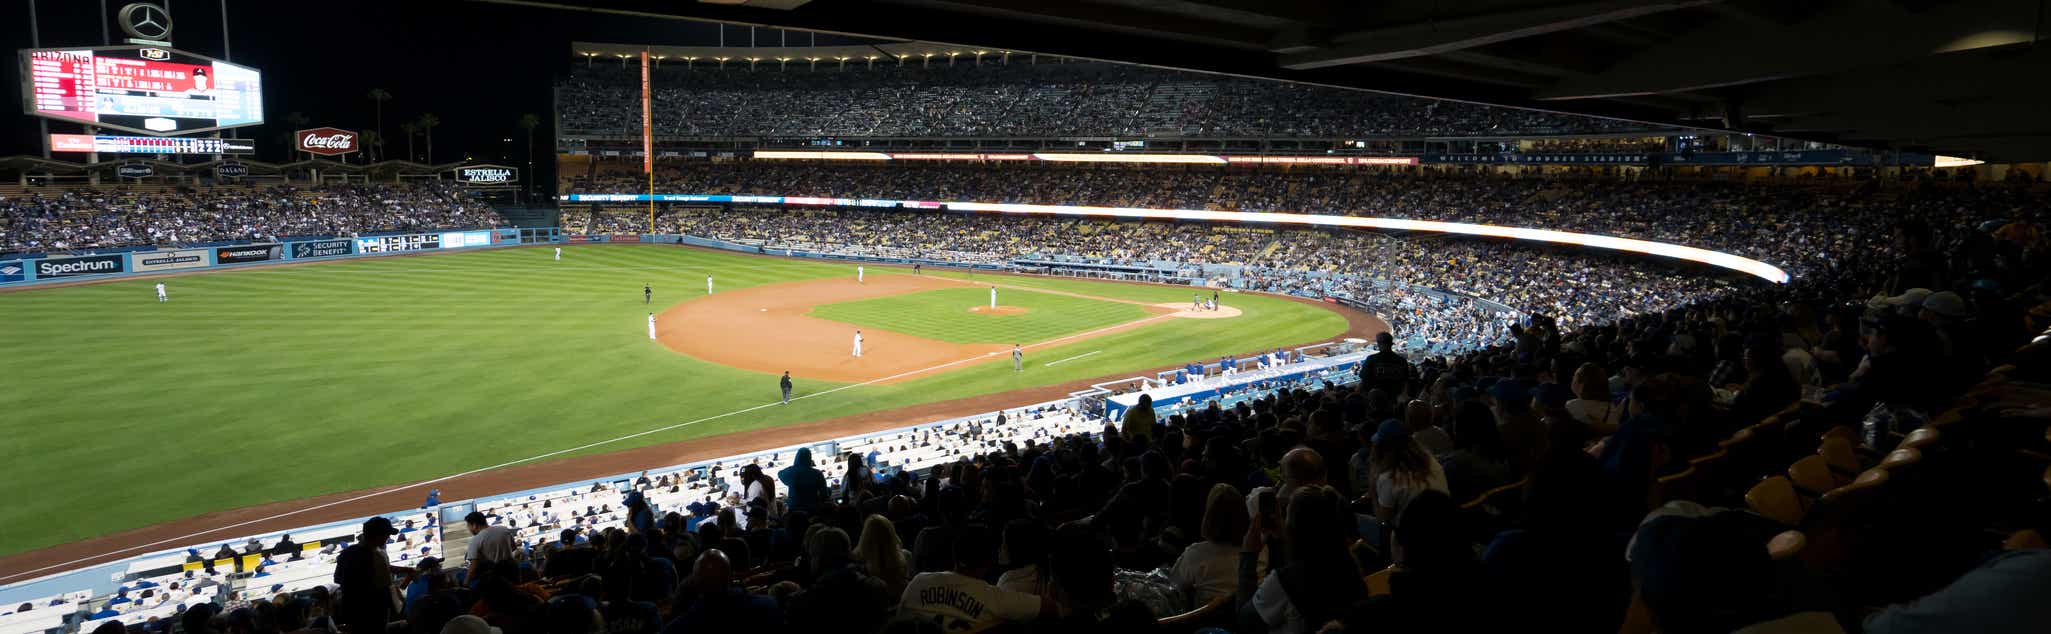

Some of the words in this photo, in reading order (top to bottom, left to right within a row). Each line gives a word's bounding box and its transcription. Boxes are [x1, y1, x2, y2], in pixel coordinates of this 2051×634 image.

[32, 51, 90, 65] ARIZONA
[303, 133, 353, 149] Coca-Cola
[313, 241, 349, 249] SECURITY
[41, 260, 114, 276] Spectrum
[920, 586, 984, 619] ROBINSON
